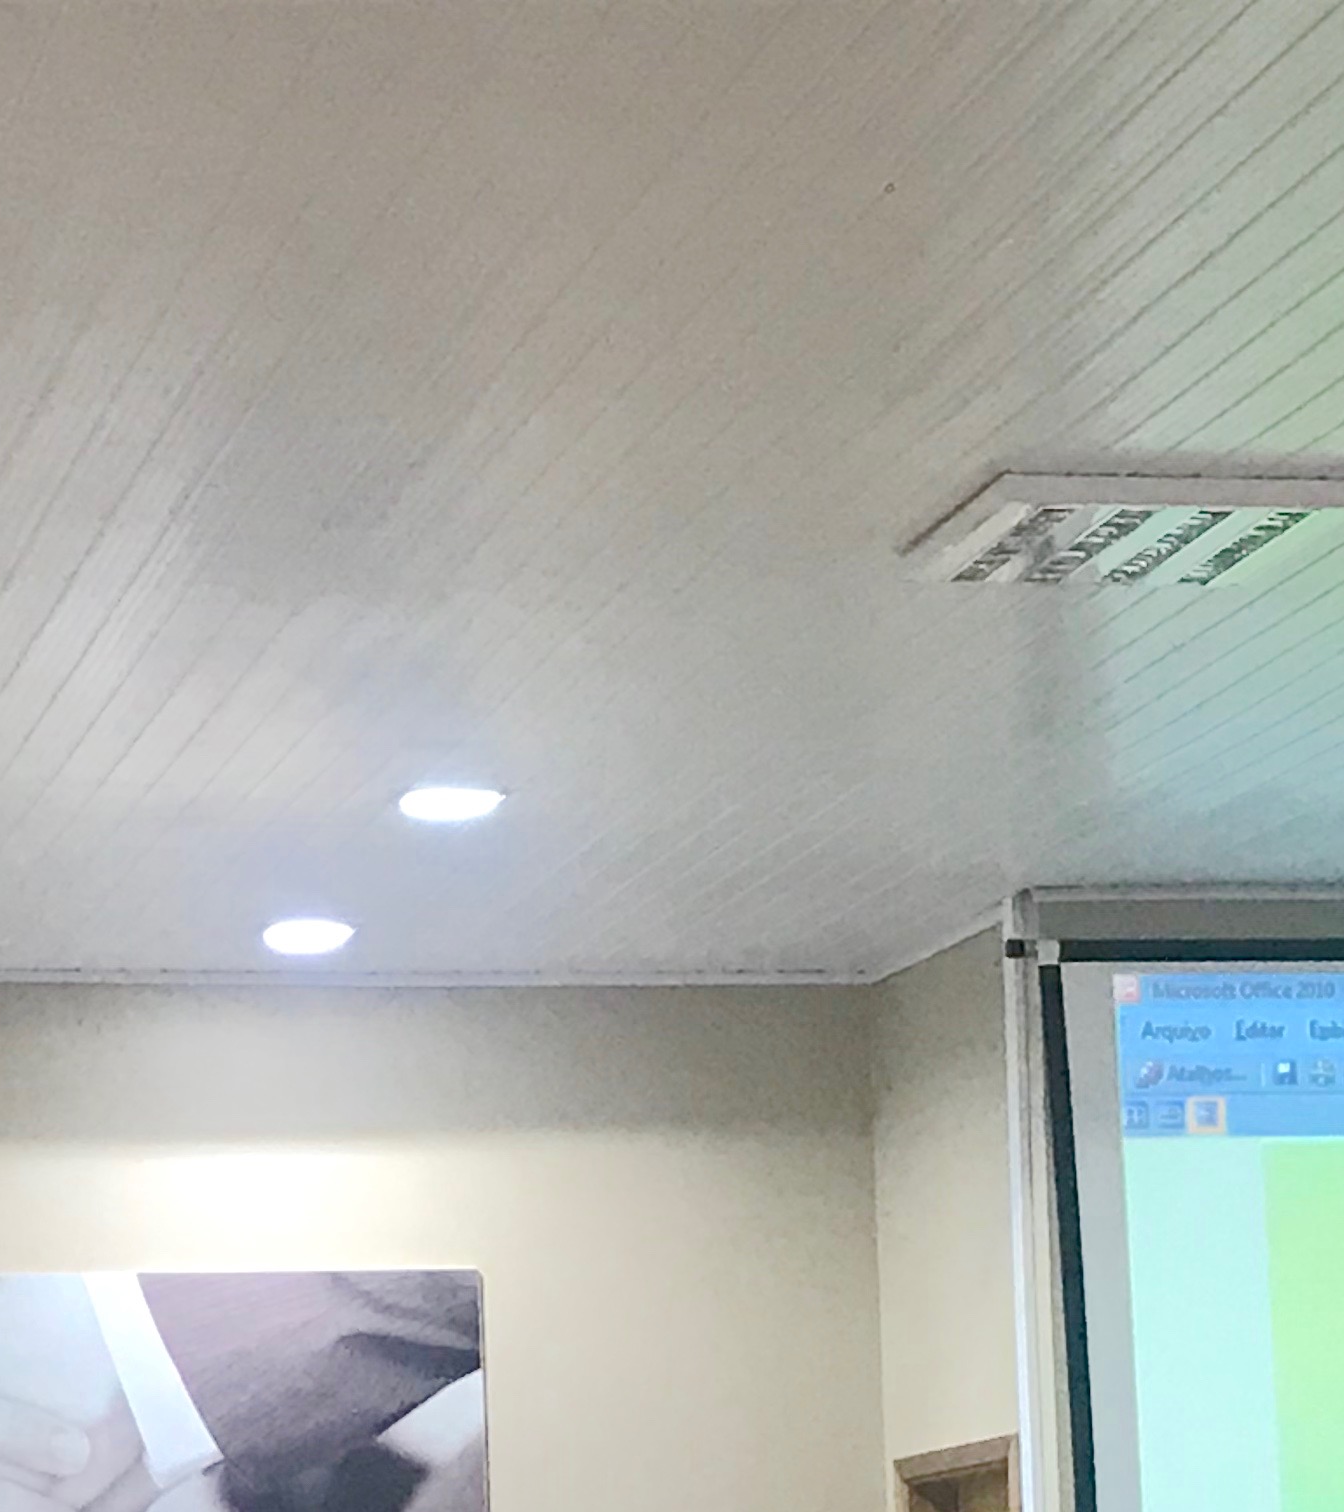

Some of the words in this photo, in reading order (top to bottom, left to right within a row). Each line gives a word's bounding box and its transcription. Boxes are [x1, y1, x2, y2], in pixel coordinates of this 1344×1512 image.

[1239, 981, 1293, 1000] Office
[1295, 980, 1335, 999] 2010
[1140, 1020, 1212, 1043] Arquivo
[1233, 1018, 1285, 1041] Editar
